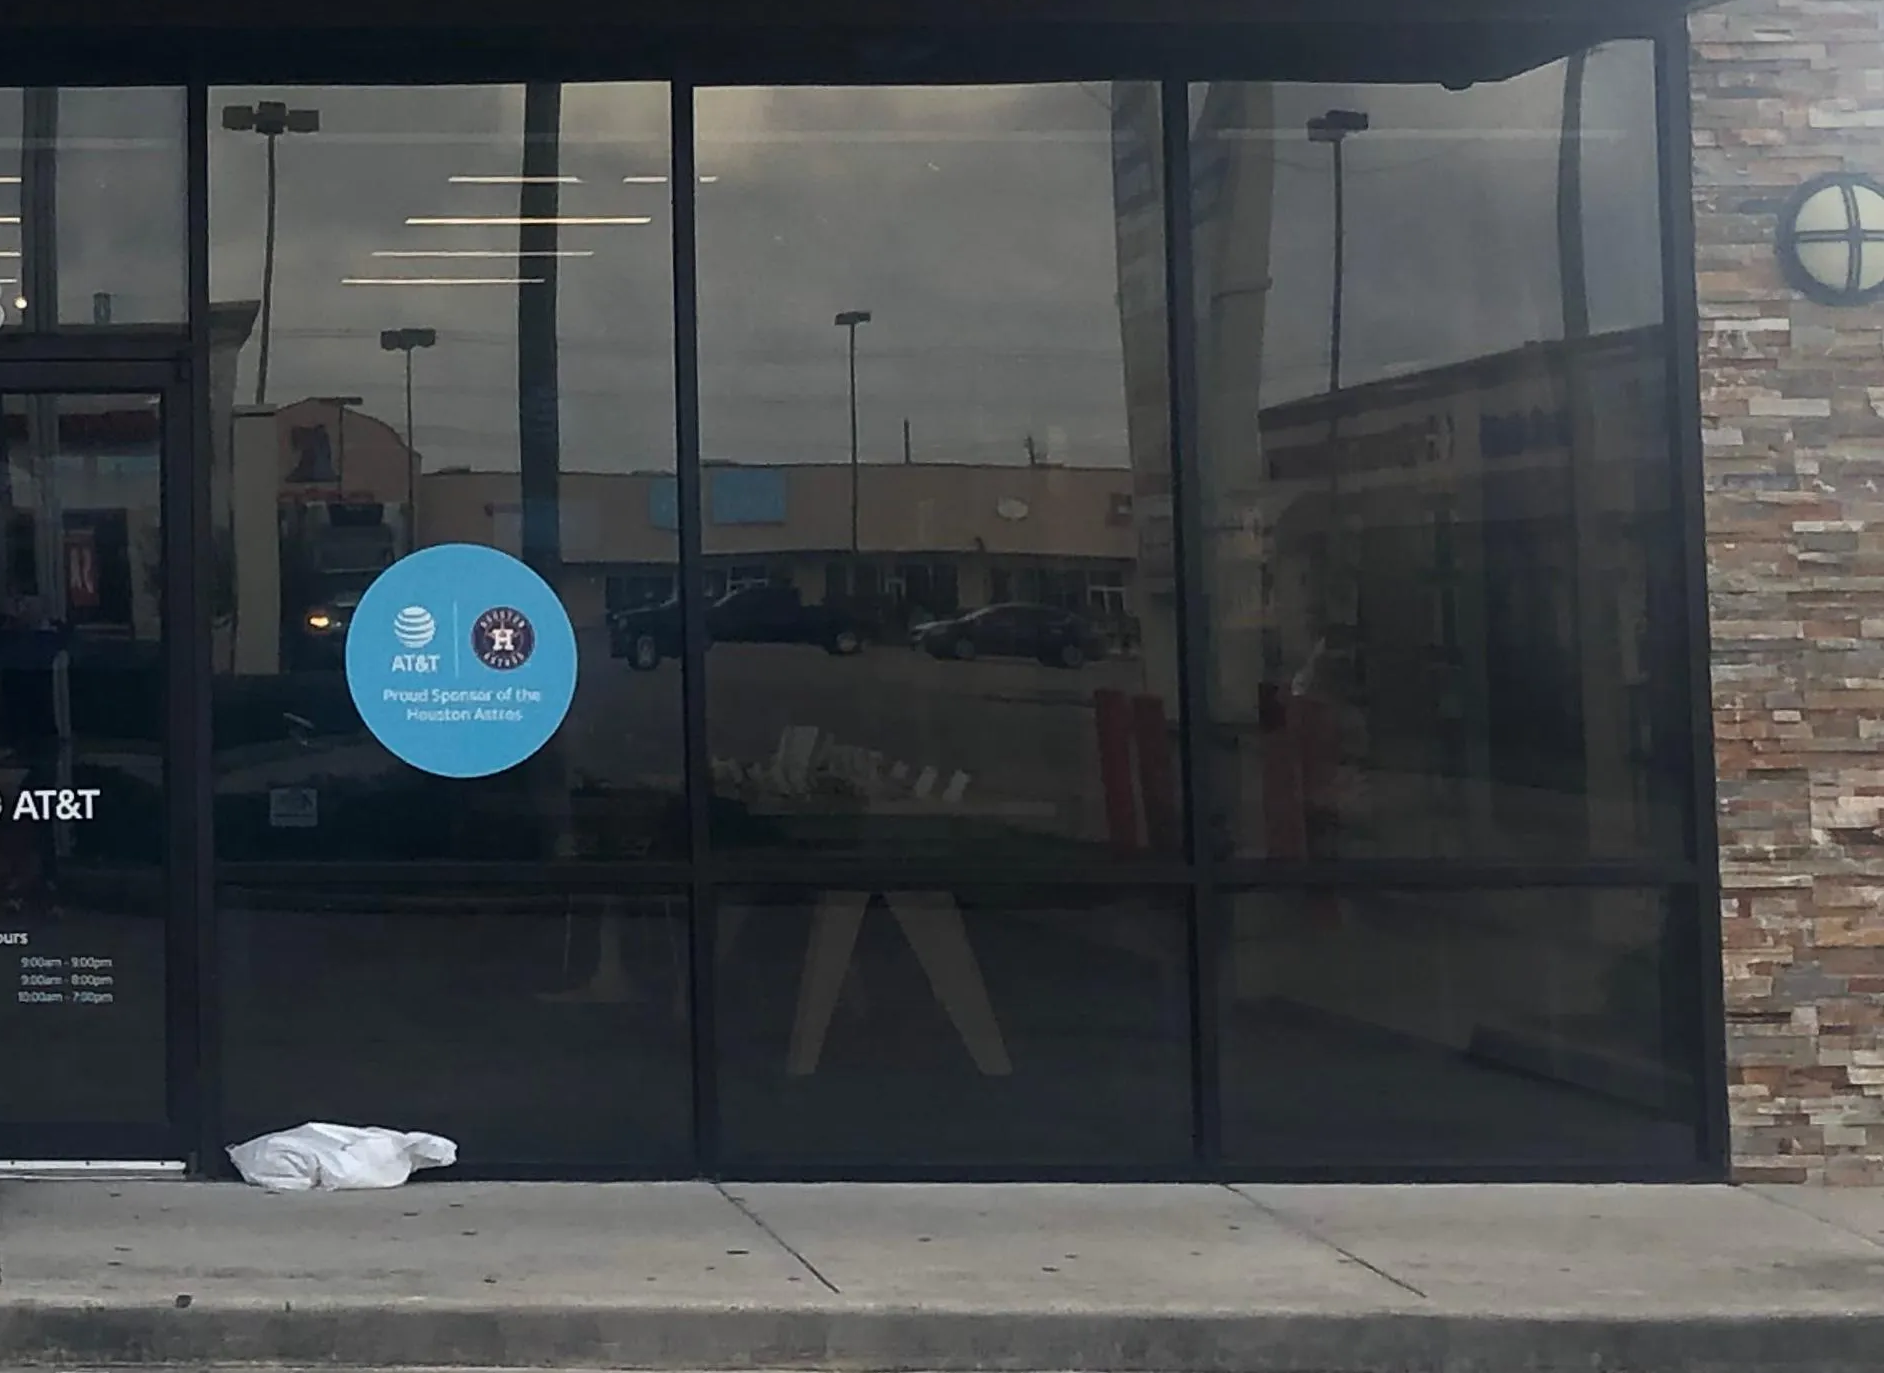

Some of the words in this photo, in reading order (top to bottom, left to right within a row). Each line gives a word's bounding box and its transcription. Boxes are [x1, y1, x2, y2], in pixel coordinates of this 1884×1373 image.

[391, 654, 441, 673] AT&T
[383, 689, 429, 702] Proud
[431, 689, 492, 705] Sponsor
[496, 687, 513, 701] of
[515, 688, 541, 702] the
[407, 709, 471, 721] Houston
[474, 708, 523, 722] Astros
[12, 789, 101, 820] AT&T
